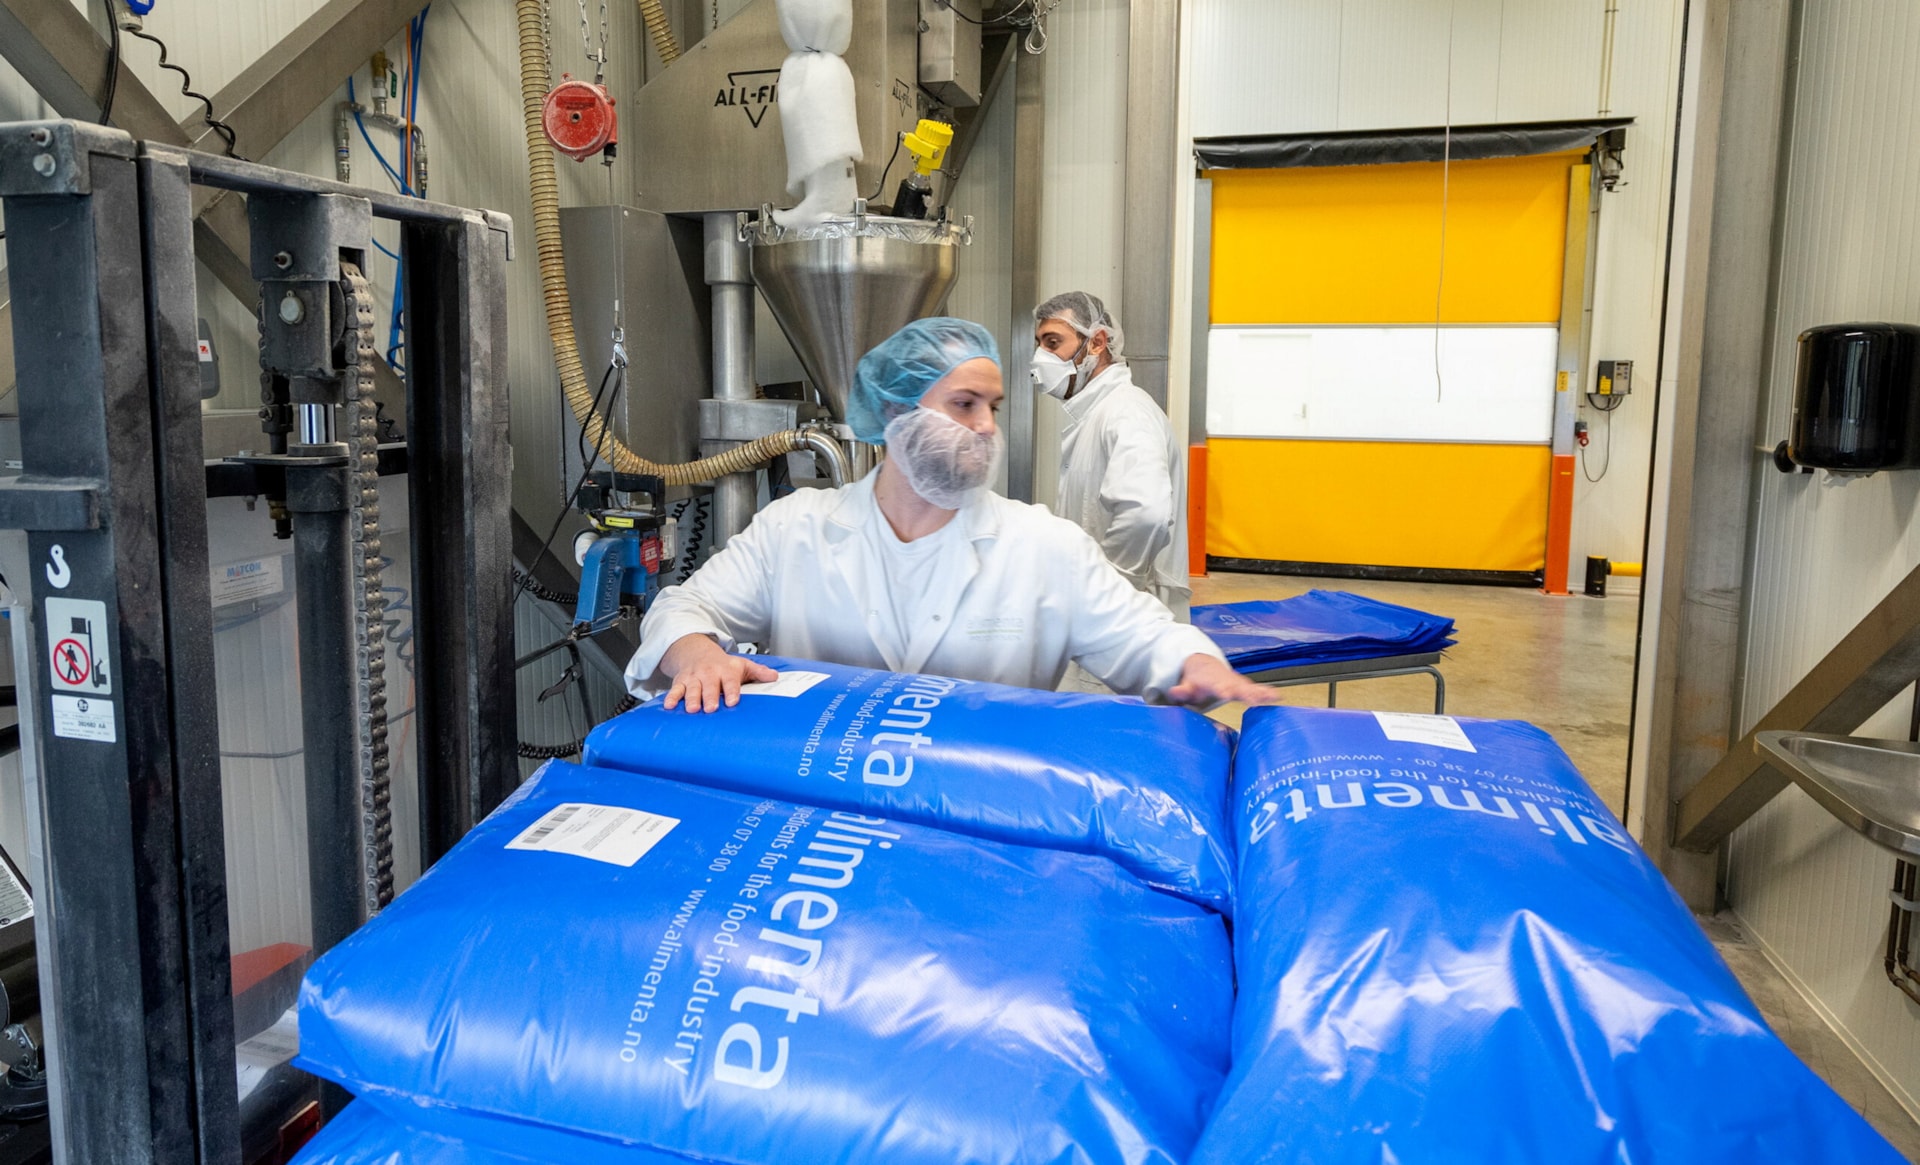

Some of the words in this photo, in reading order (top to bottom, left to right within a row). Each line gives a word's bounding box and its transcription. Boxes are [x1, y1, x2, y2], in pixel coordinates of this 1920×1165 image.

[714, 84, 778, 107] ALL-FI
[870, 687, 893, 699] the
[797, 693, 848, 777] www.alimenta.no
[827, 698, 884, 782] food-industry
[1414, 758, 1437, 768] 00
[1442, 763, 1466, 773] 38
[1244, 754, 1384, 796] www.alimenta.no
[1389, 768, 1428, 781] the
[1437, 774, 1469, 787] for
[1473, 768, 1496, 778] 07
[1503, 774, 1524, 783] 67
[1246, 768, 1384, 815] food-industry
[743, 815, 761, 828] 67
[1249, 782, 1634, 855] alimenta
[732, 828, 752, 842] 07
[720, 842, 743, 858] 38
[708, 857, 731, 873] 00
[757, 851, 788, 872] for
[739, 872, 773, 900] the
[714, 811, 901, 1090] alimenta
[619, 888, 707, 1063] www.alimenta.no
[664, 901, 757, 1076] food-industry
